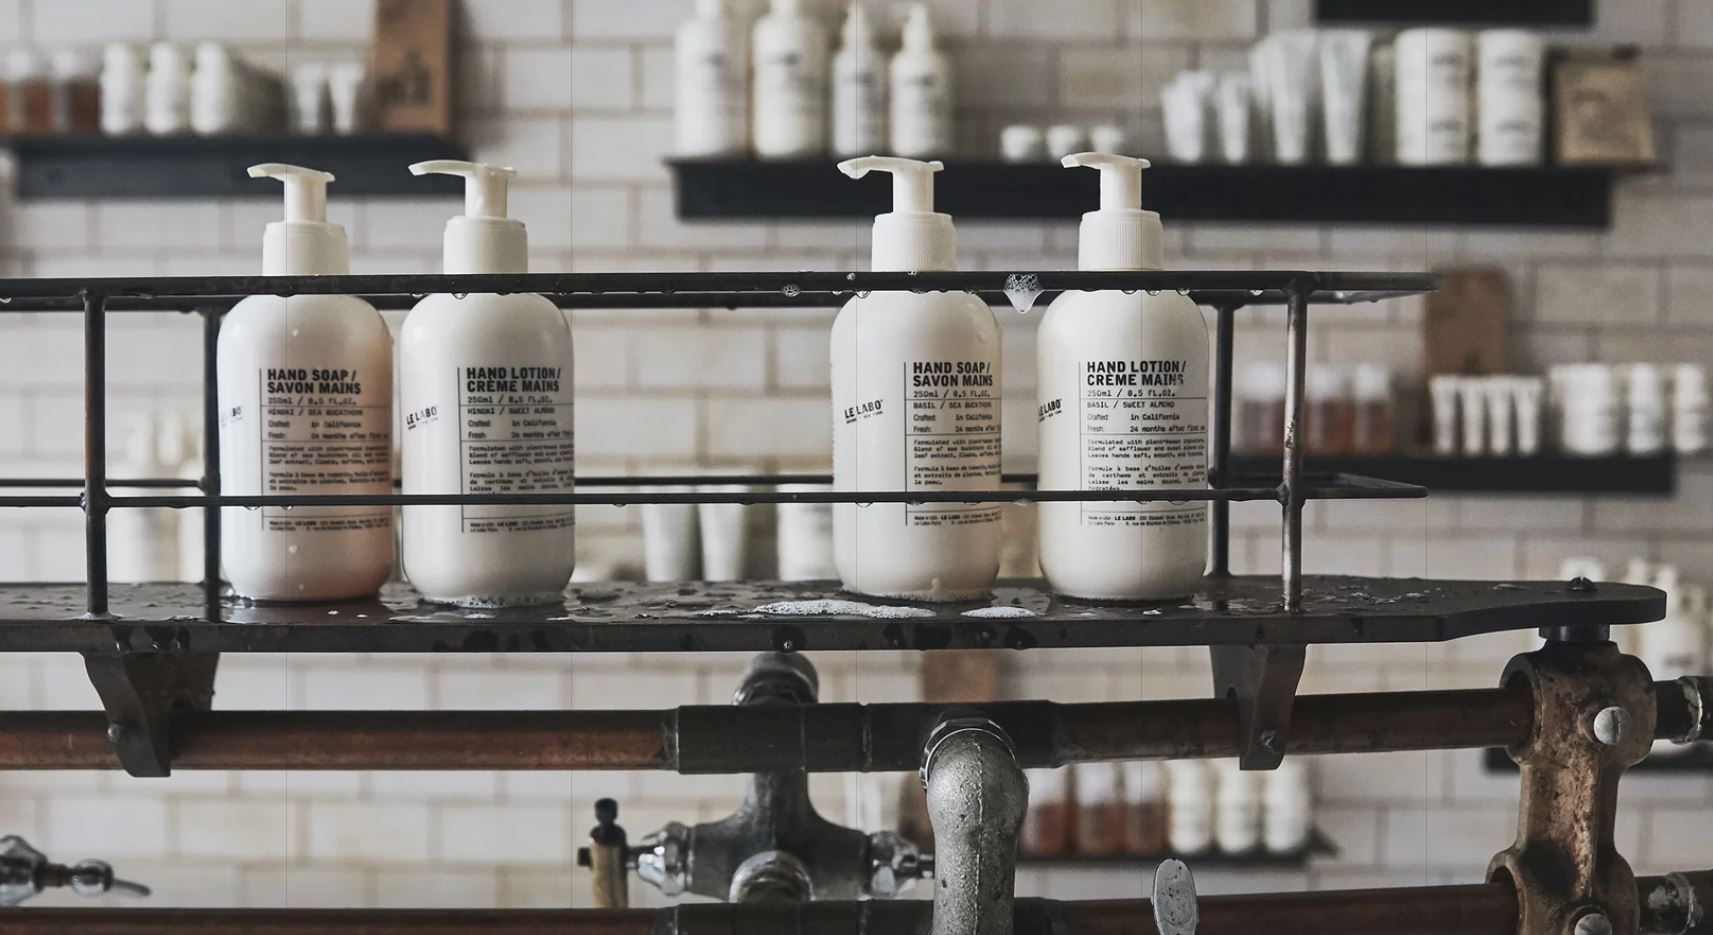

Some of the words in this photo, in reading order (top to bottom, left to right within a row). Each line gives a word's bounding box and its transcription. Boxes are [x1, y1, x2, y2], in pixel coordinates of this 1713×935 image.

[467, 367, 506, 379] HAND
[913, 362, 952, 374] HAND
[1087, 361, 1126, 373] HAND
[267, 369, 307, 381] HAND
[913, 375, 958, 386] SAVON
[963, 375, 993, 386] MAINS
[1088, 374, 1136, 386] CRÈME
[1142, 374, 1183, 386] MAINS
[267, 382, 314, 394] SAVON
[319, 382, 361, 394] MAINS
[467, 380, 517, 392] CRÈME
[522, 380, 559, 392] MAINS
[467, 395, 493, 403] 250ml
[913, 390, 939, 398] 250ml
[1127, 389, 1143, 397] 8.5
[844, 407, 855, 419] LE
[855, 400, 881, 415] LABO
[1044, 399, 1061, 414] LABO
